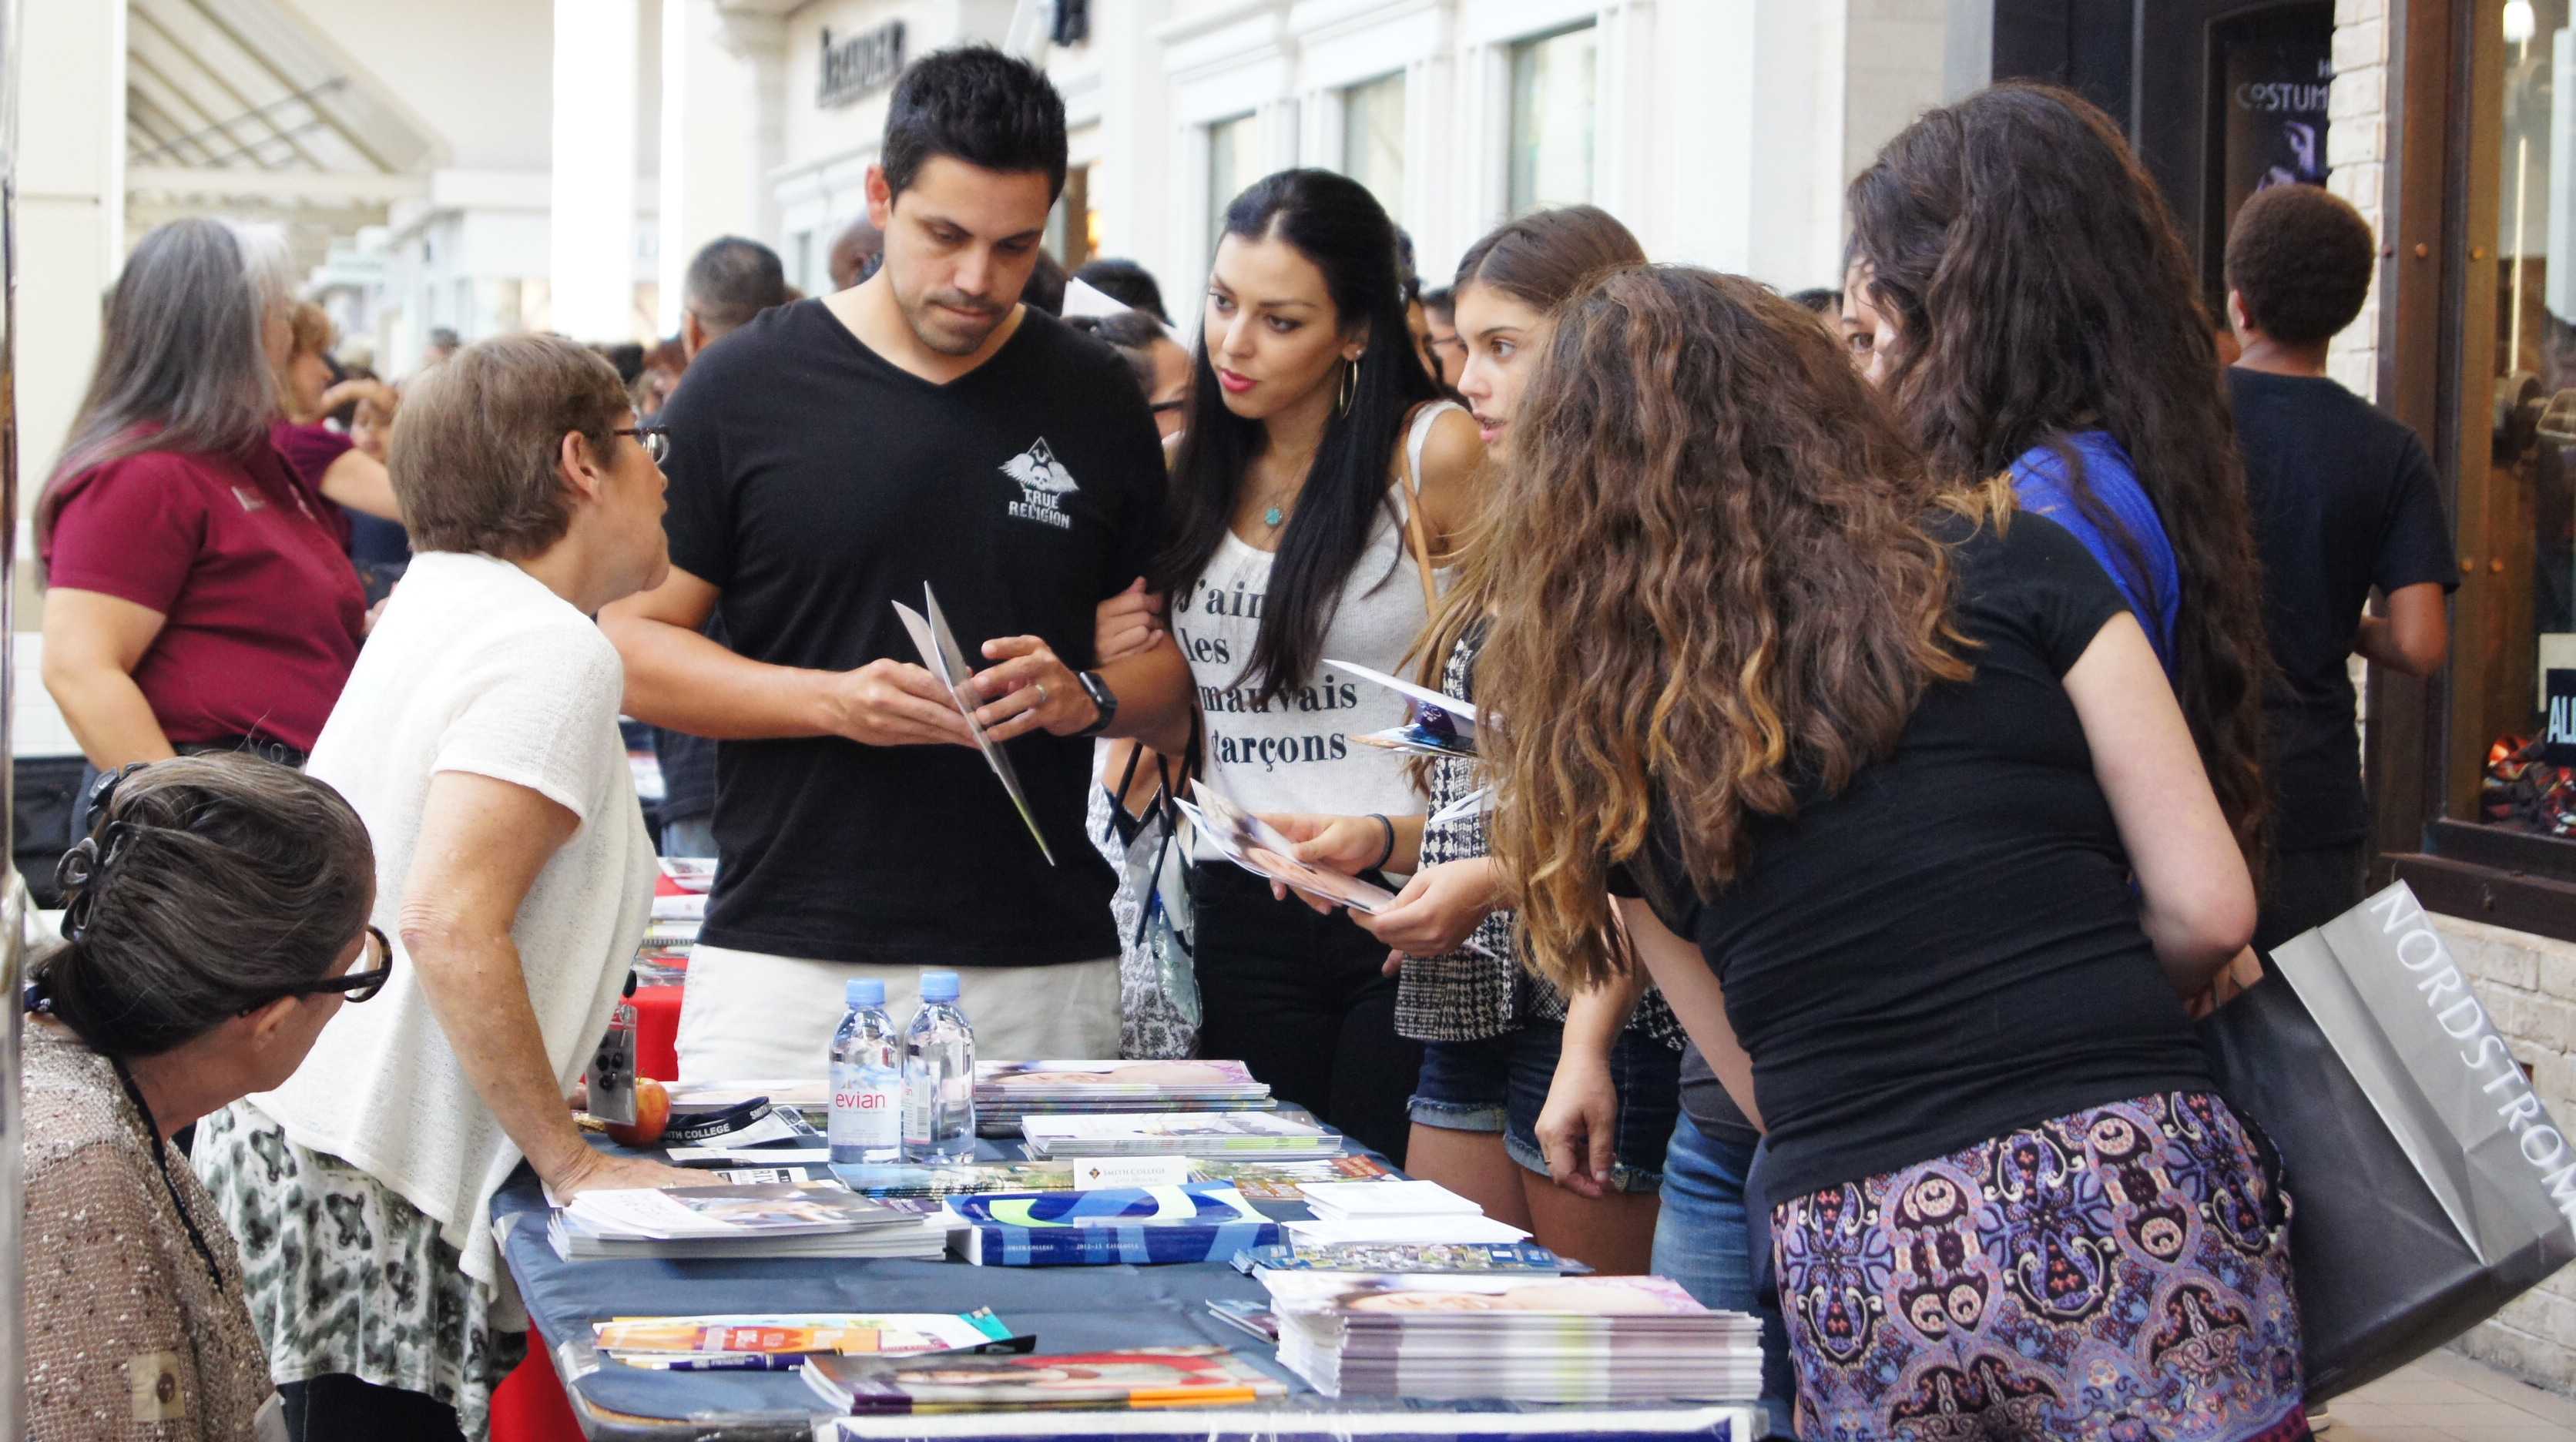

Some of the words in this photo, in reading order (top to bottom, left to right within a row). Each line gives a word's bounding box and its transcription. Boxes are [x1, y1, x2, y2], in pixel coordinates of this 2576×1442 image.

[1024, 488, 1058, 509] TRUE
[1008, 501, 1071, 529] RELIGION
[1179, 627, 1231, 664] les
[2370, 887, 2576, 1214] NORDSTROM
[835, 1091, 886, 1108] evian
[684, 1123, 730, 1139] COLLEGE
